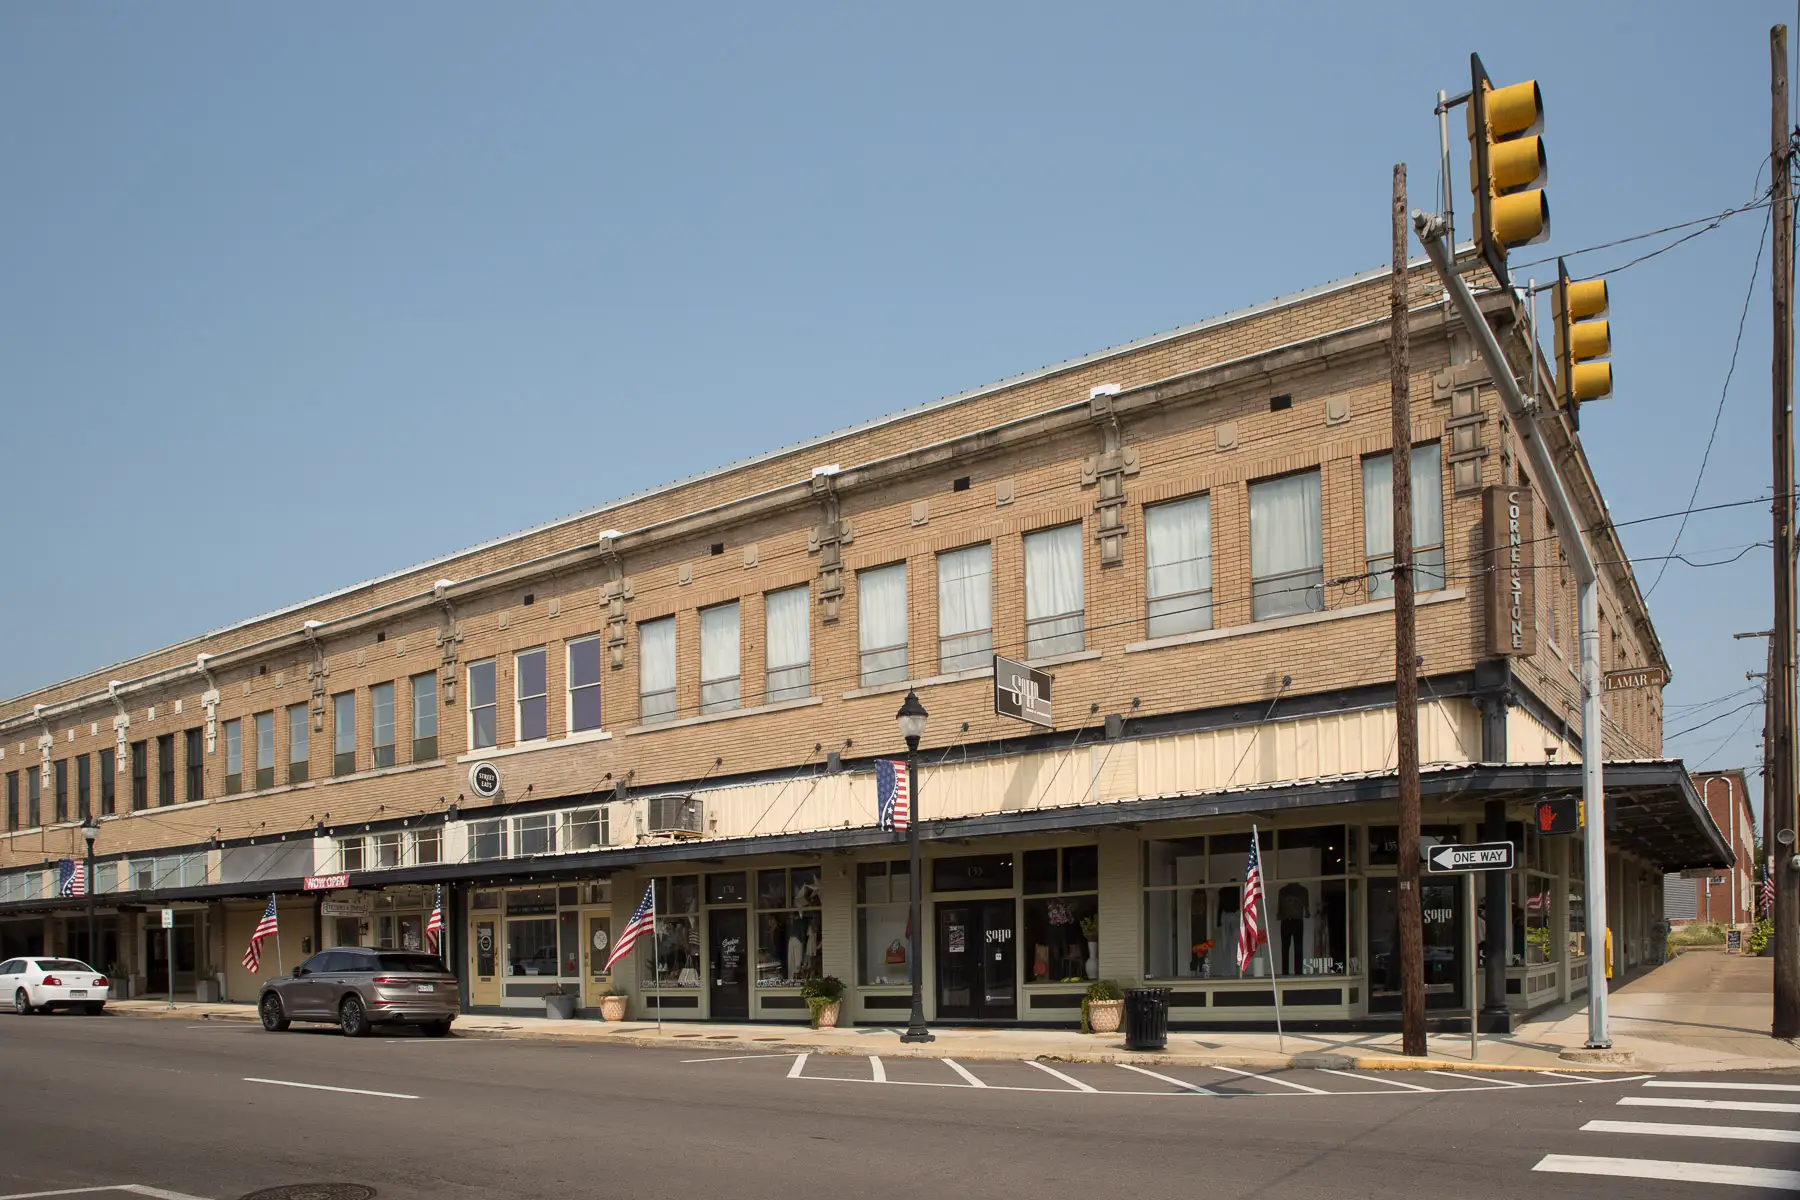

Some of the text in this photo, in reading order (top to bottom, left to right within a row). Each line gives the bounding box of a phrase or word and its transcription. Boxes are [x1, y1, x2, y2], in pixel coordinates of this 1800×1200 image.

[1508, 491, 1523, 649] CORNERSTONE
[1608, 674, 1647, 689] LAMAR
[478, 773, 495, 781] STREET
[481, 781, 492, 789] EATS
[1453, 850, 1504, 863] ONE WAY
[307, 875, 346, 889] NOW OPEN
